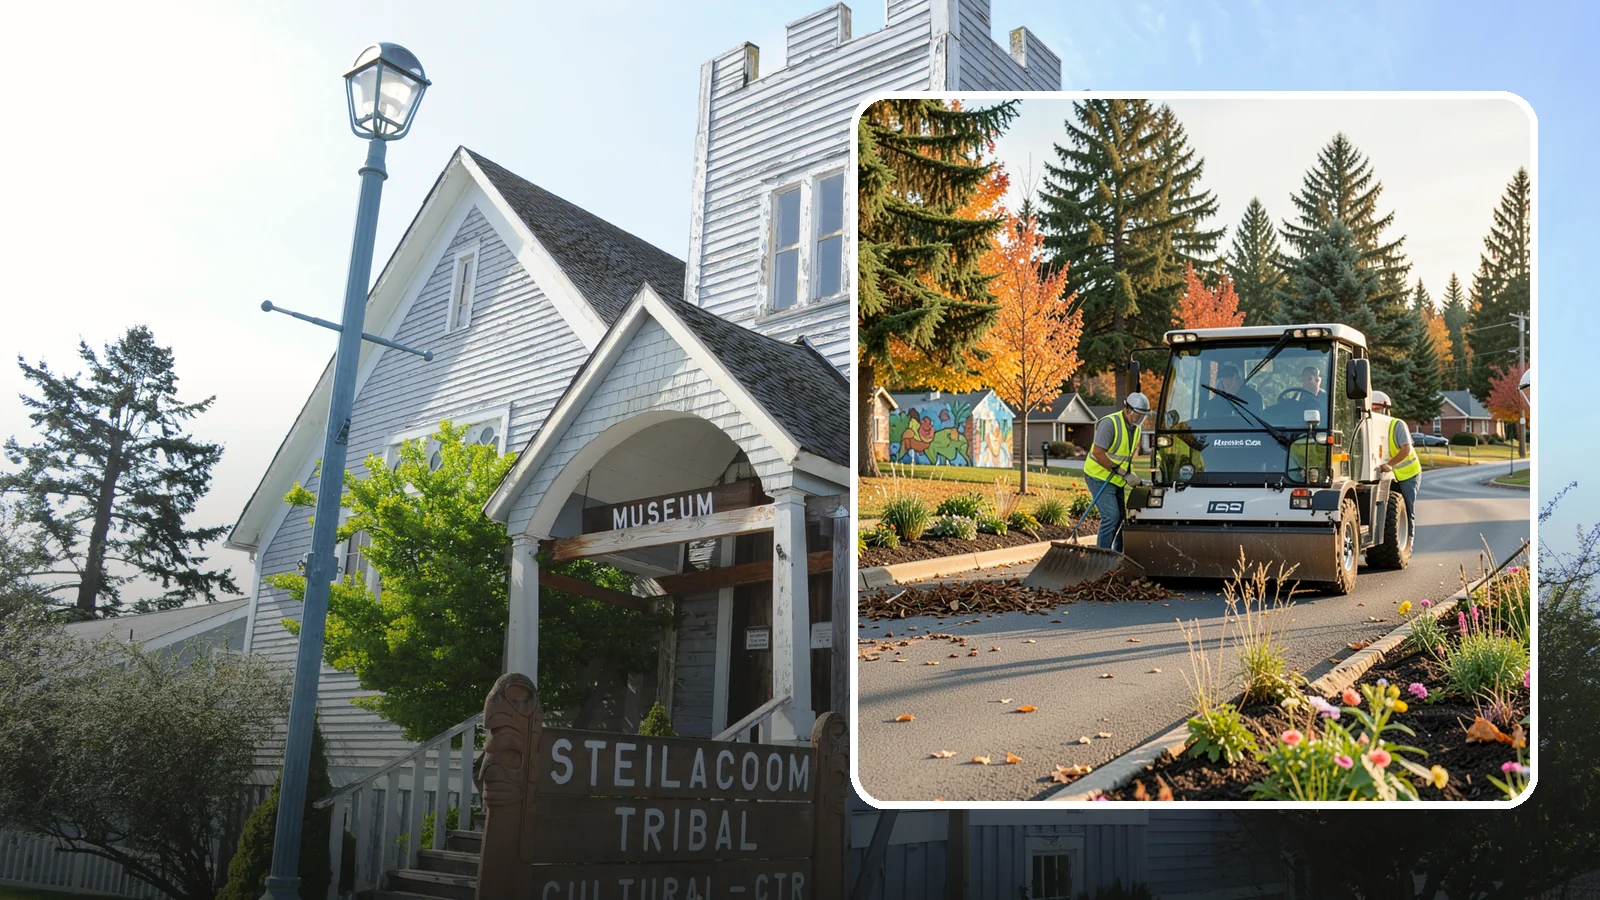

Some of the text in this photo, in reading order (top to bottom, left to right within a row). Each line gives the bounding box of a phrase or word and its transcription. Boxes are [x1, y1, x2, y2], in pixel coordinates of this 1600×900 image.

[612, 491, 713, 531] MUSEUM
[550, 738, 809, 793] STEILACOOM
[615, 806, 758, 852] TRIBAL
